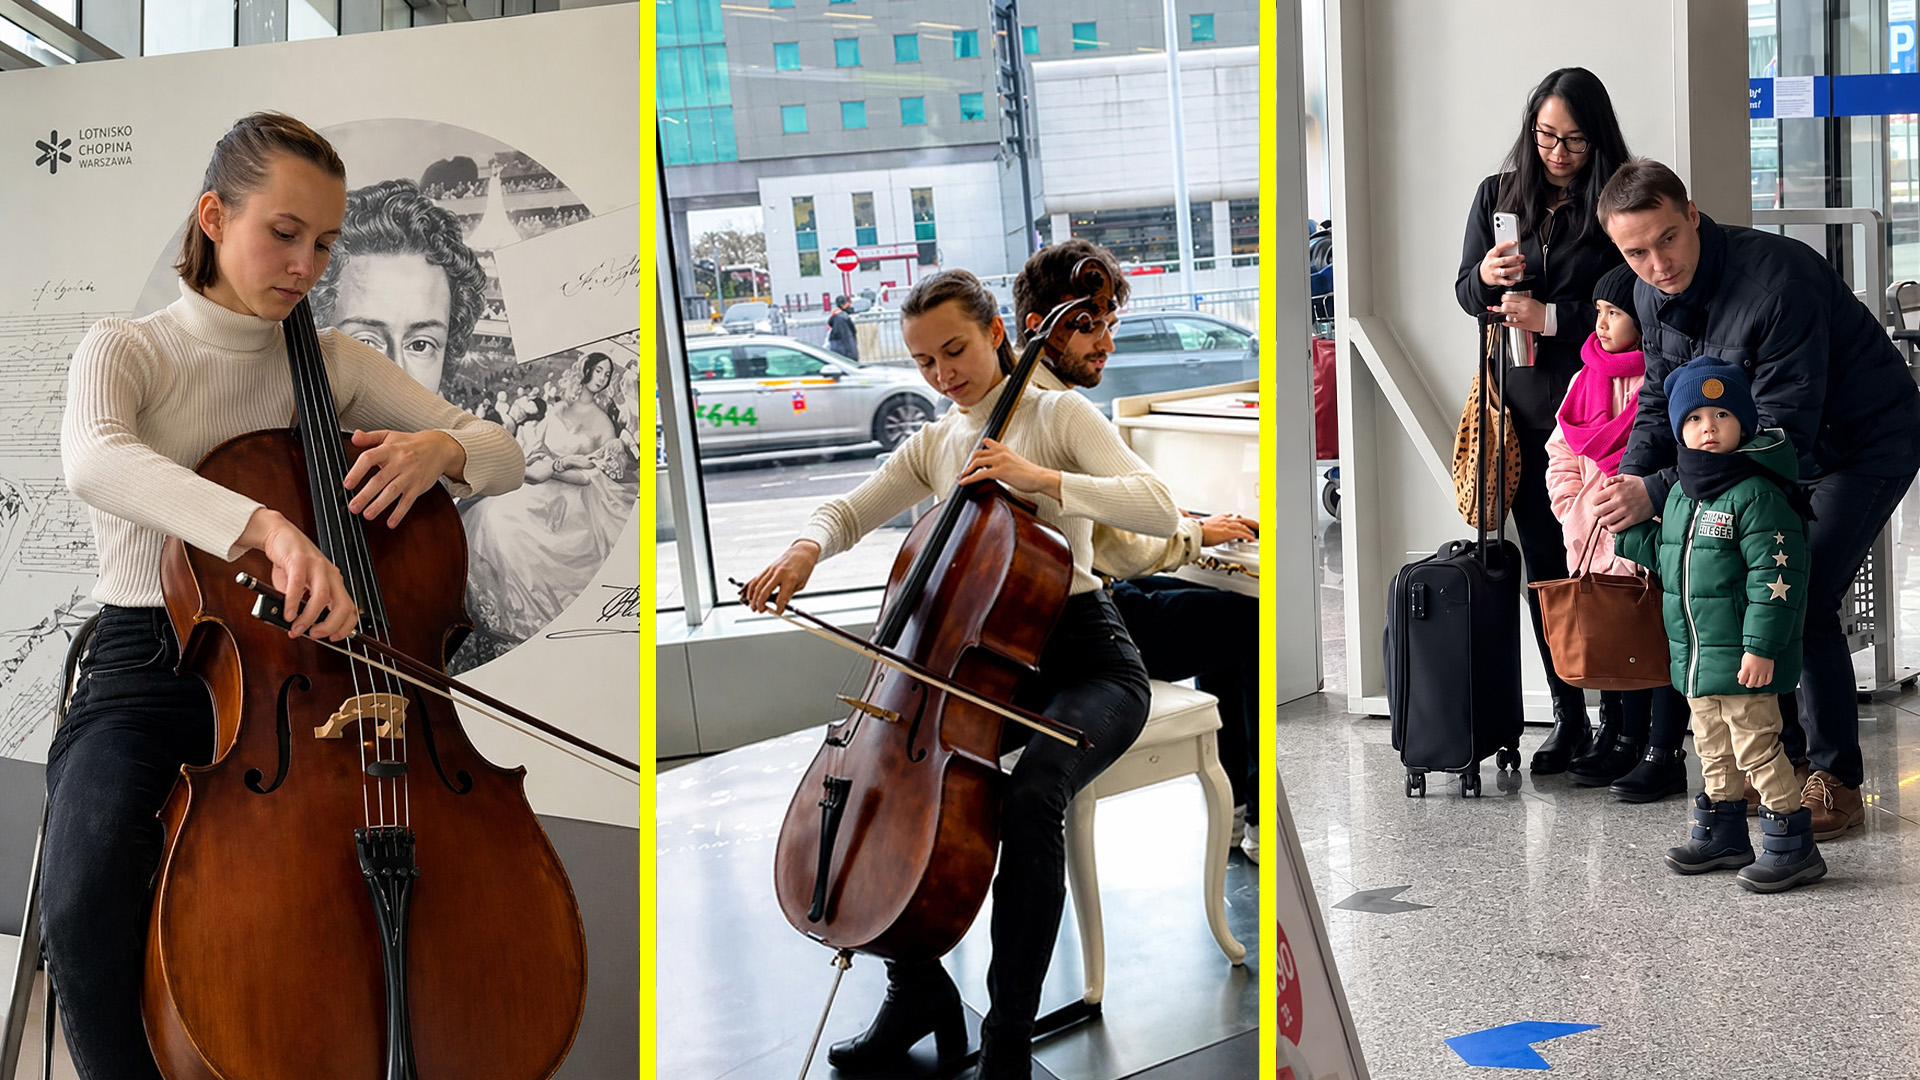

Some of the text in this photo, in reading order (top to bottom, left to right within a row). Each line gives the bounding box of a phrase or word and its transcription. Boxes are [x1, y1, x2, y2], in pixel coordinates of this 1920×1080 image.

[1890, 24, 1914, 63] P
[79, 125, 133, 140] LOTNISKO
[78, 141, 133, 155] CHOPINA
[79, 156, 133, 168] WARSZAWA
